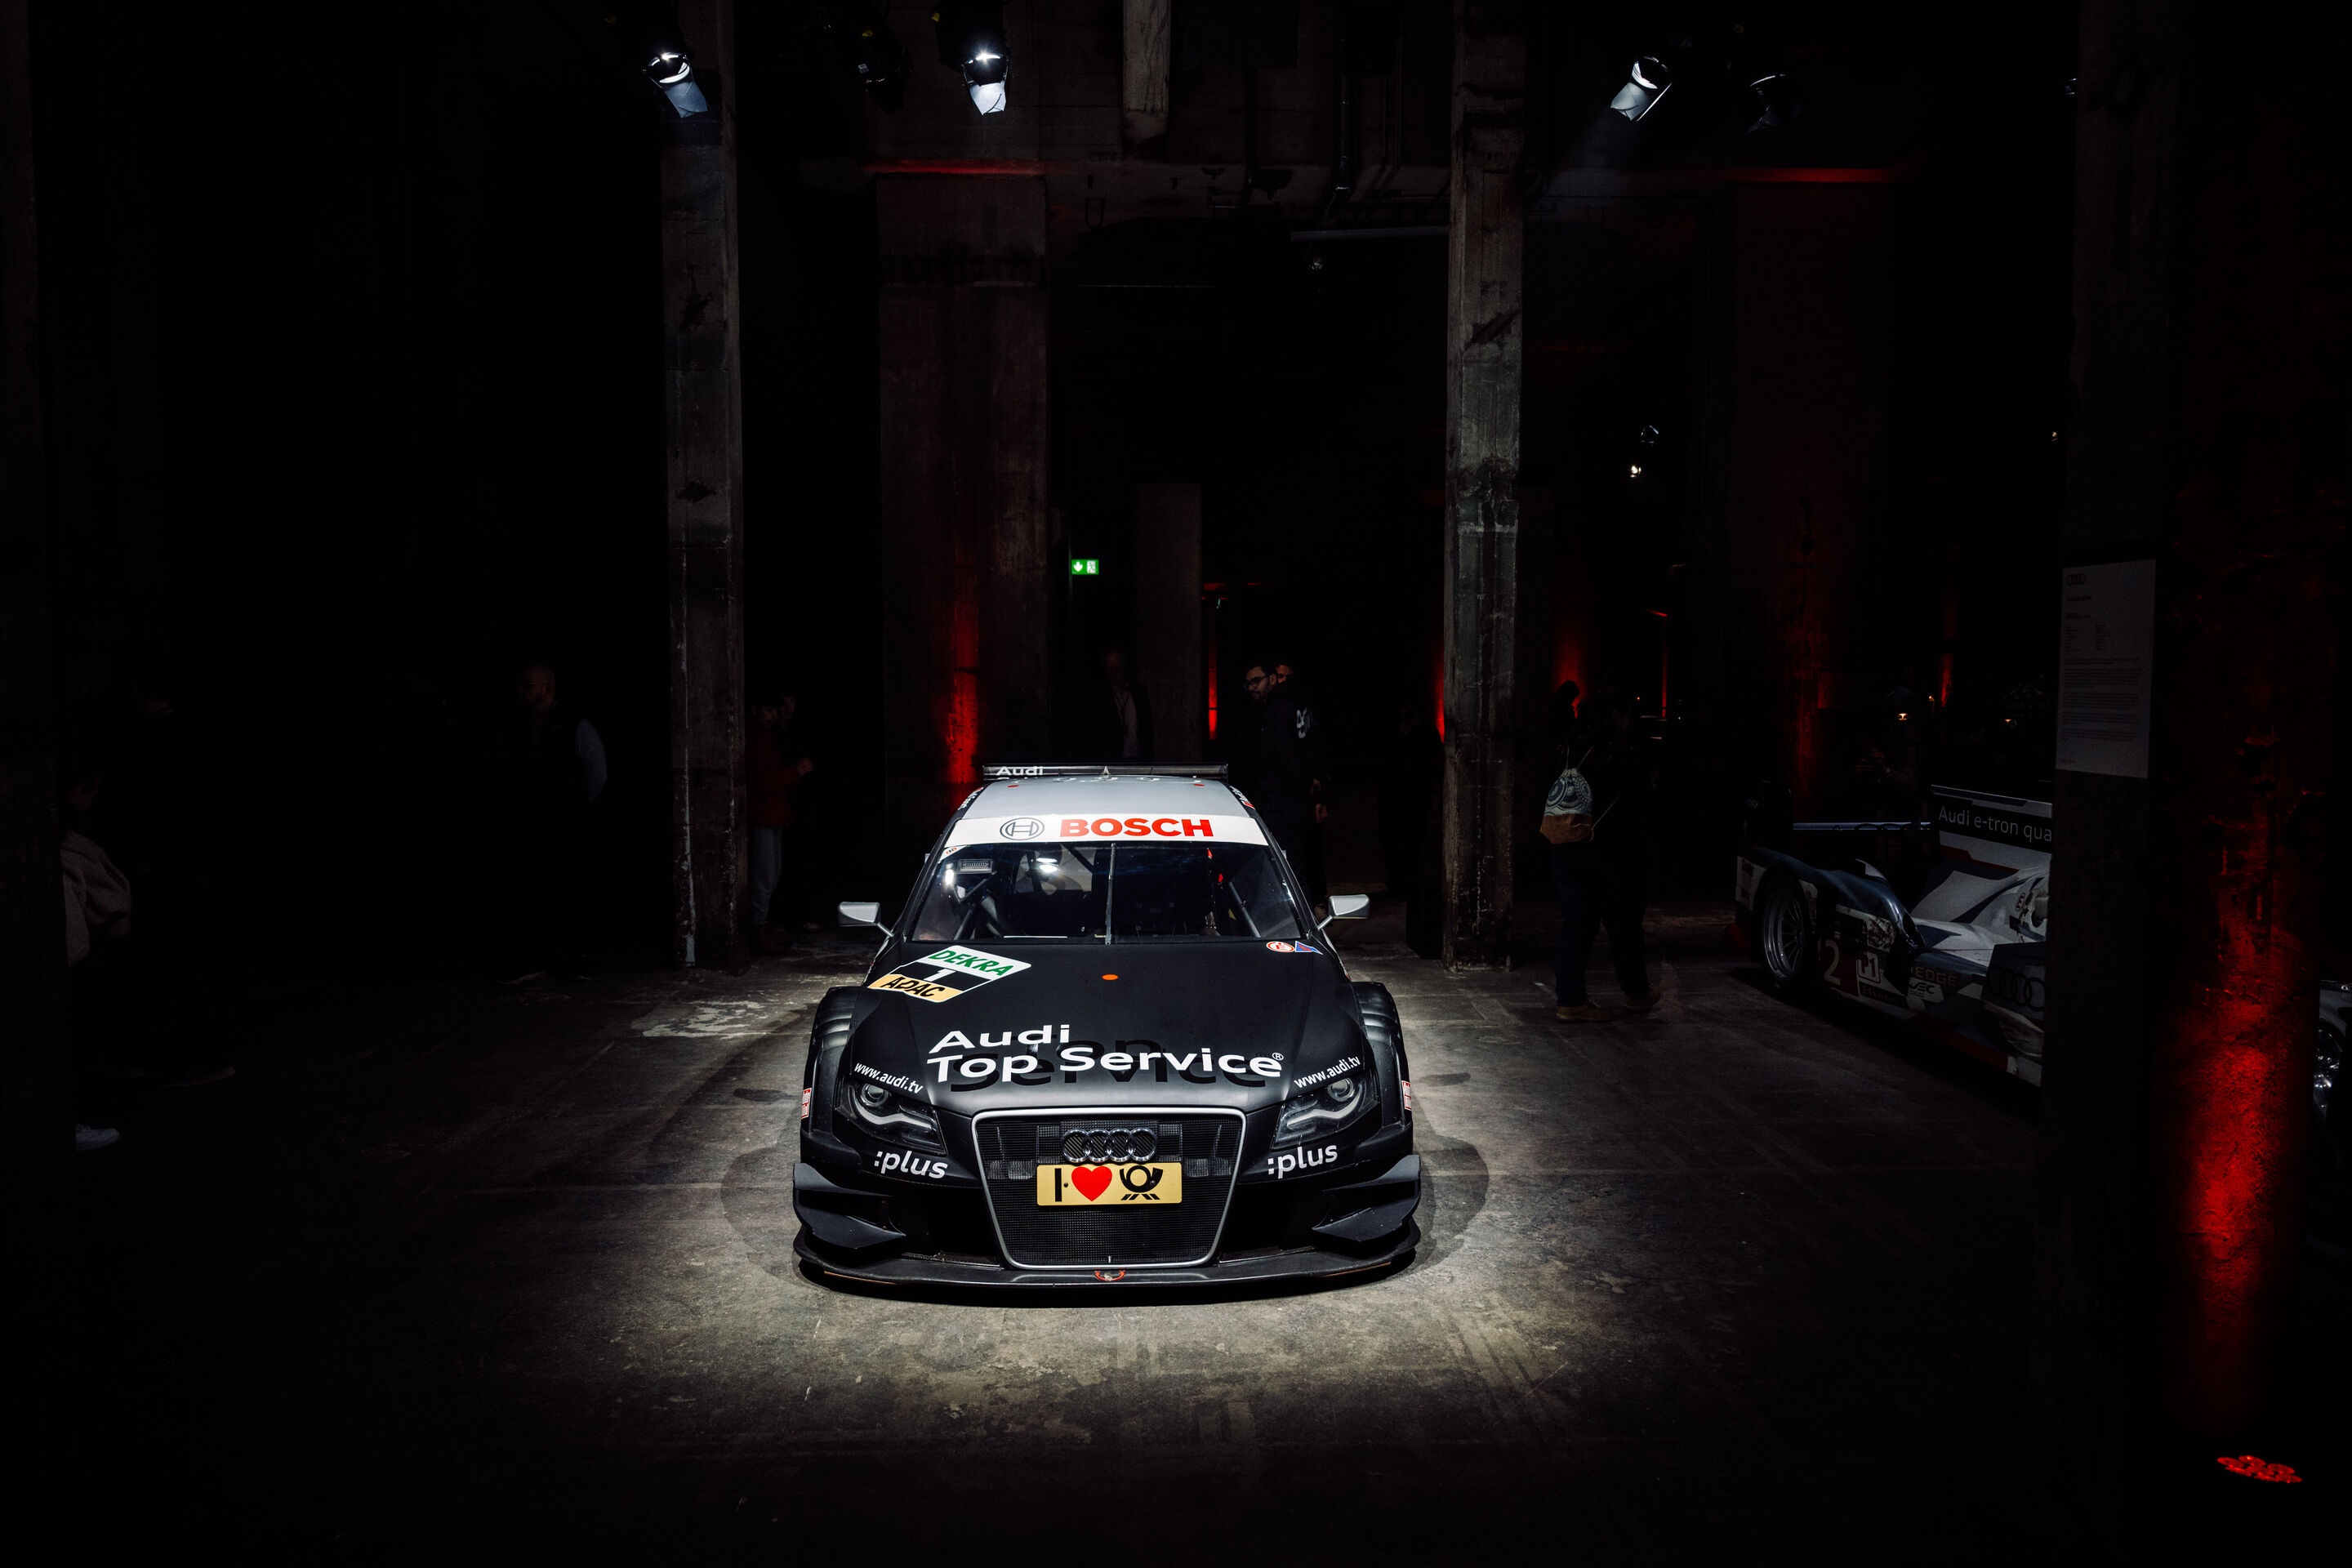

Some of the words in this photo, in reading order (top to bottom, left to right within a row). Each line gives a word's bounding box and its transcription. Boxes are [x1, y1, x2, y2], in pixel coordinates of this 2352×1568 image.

[996, 766, 1044, 776] Audi
[1061, 817, 1214, 837] BOSCH
[1938, 805, 1970, 826] Audi
[1974, 817, 2019, 835] e-tron
[927, 950, 1013, 977] DEKRA
[1915, 966, 1958, 987] EDGE
[880, 976, 946, 998] ADAC
[928, 1024, 1071, 1054] Audi
[854, 1062, 924, 1094] www.audi.tv
[926, 1054, 1039, 1083] Top
[1294, 1055, 1361, 1089] www.audi.tv
